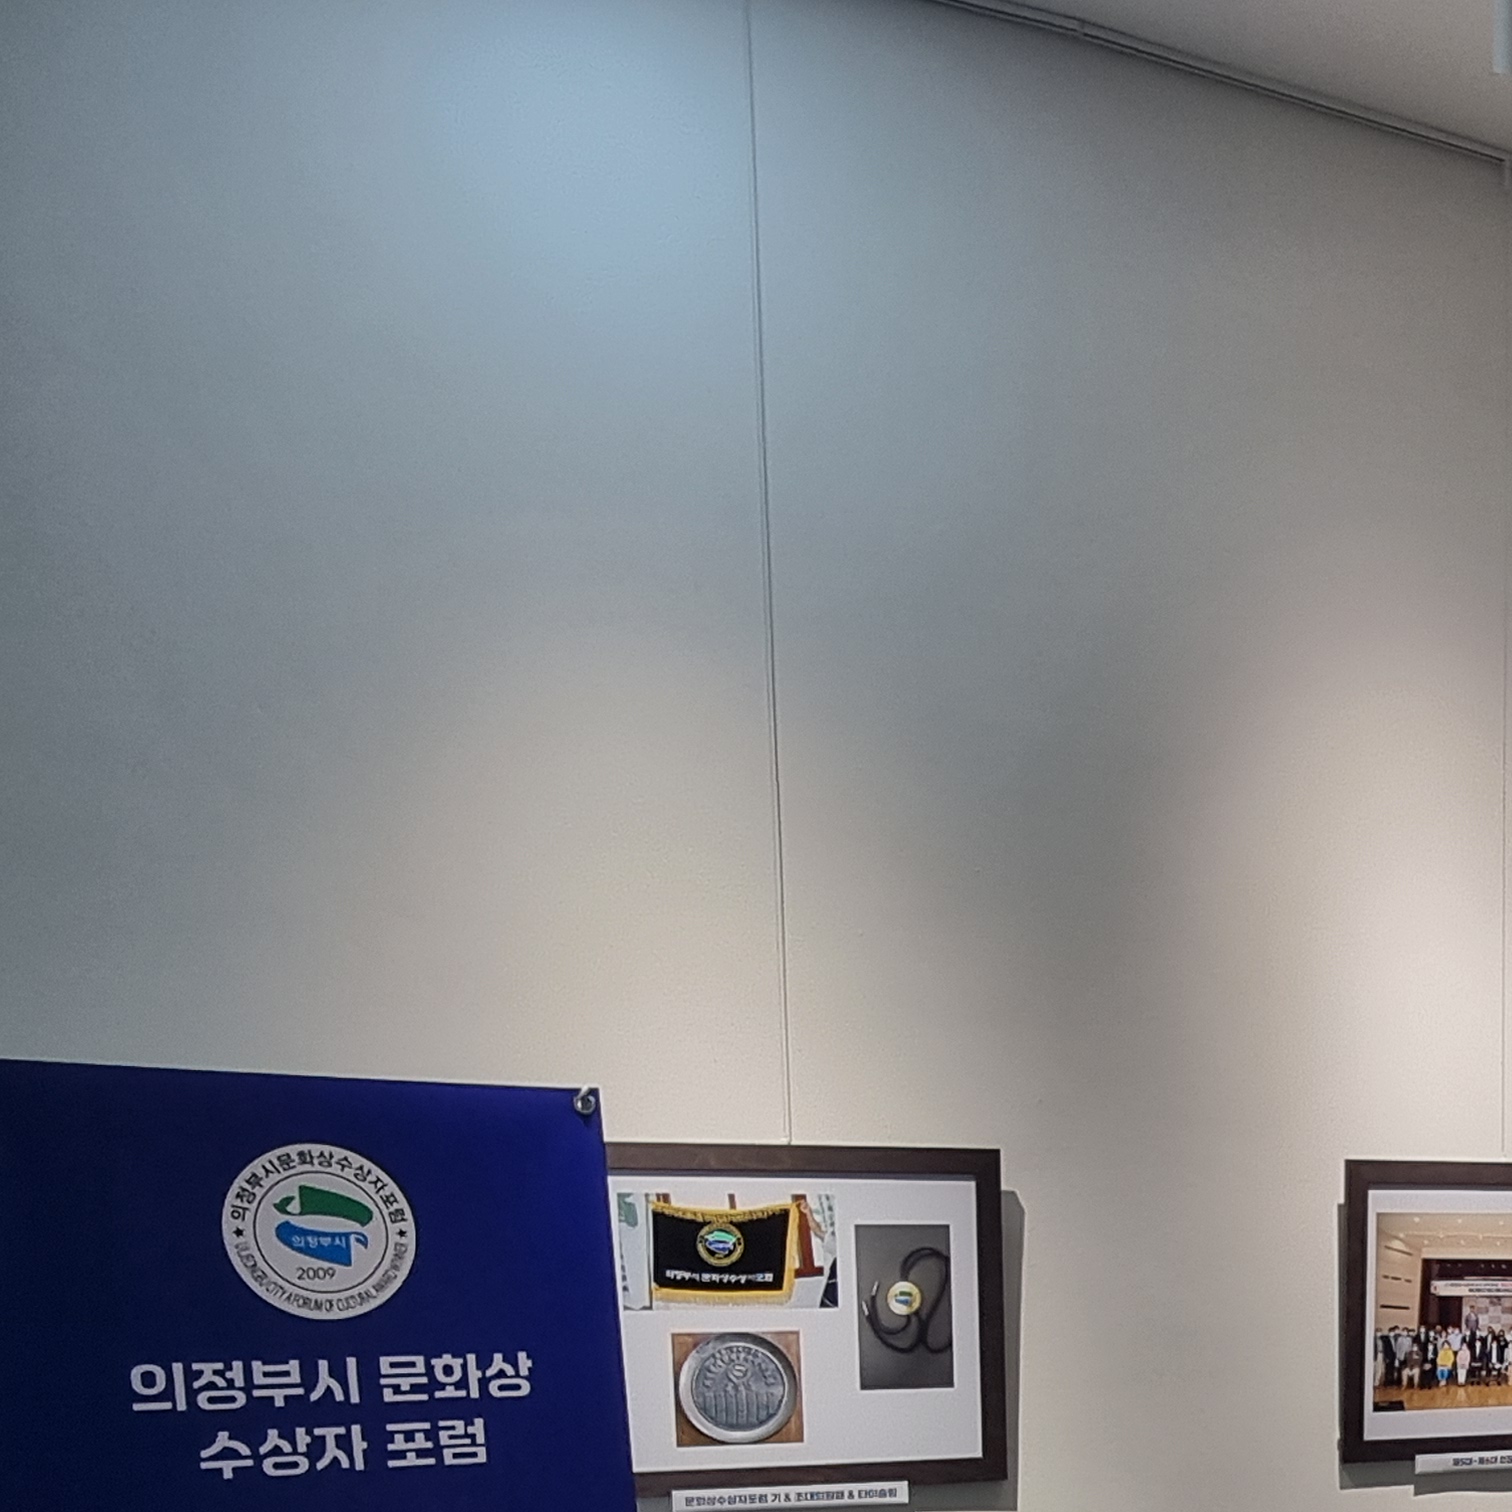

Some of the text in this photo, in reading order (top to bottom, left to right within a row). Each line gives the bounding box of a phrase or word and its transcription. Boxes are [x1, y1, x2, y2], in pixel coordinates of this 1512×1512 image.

[230, 1149, 408, 1224] 의정부시문화상수상자포럼
[291, 1235, 347, 1249] 의정부시
[296, 1267, 337, 1281] 2009
[130, 1351, 533, 1412] 의정부시 문화상
[199, 1417, 487, 1479] 수상자 포럼
